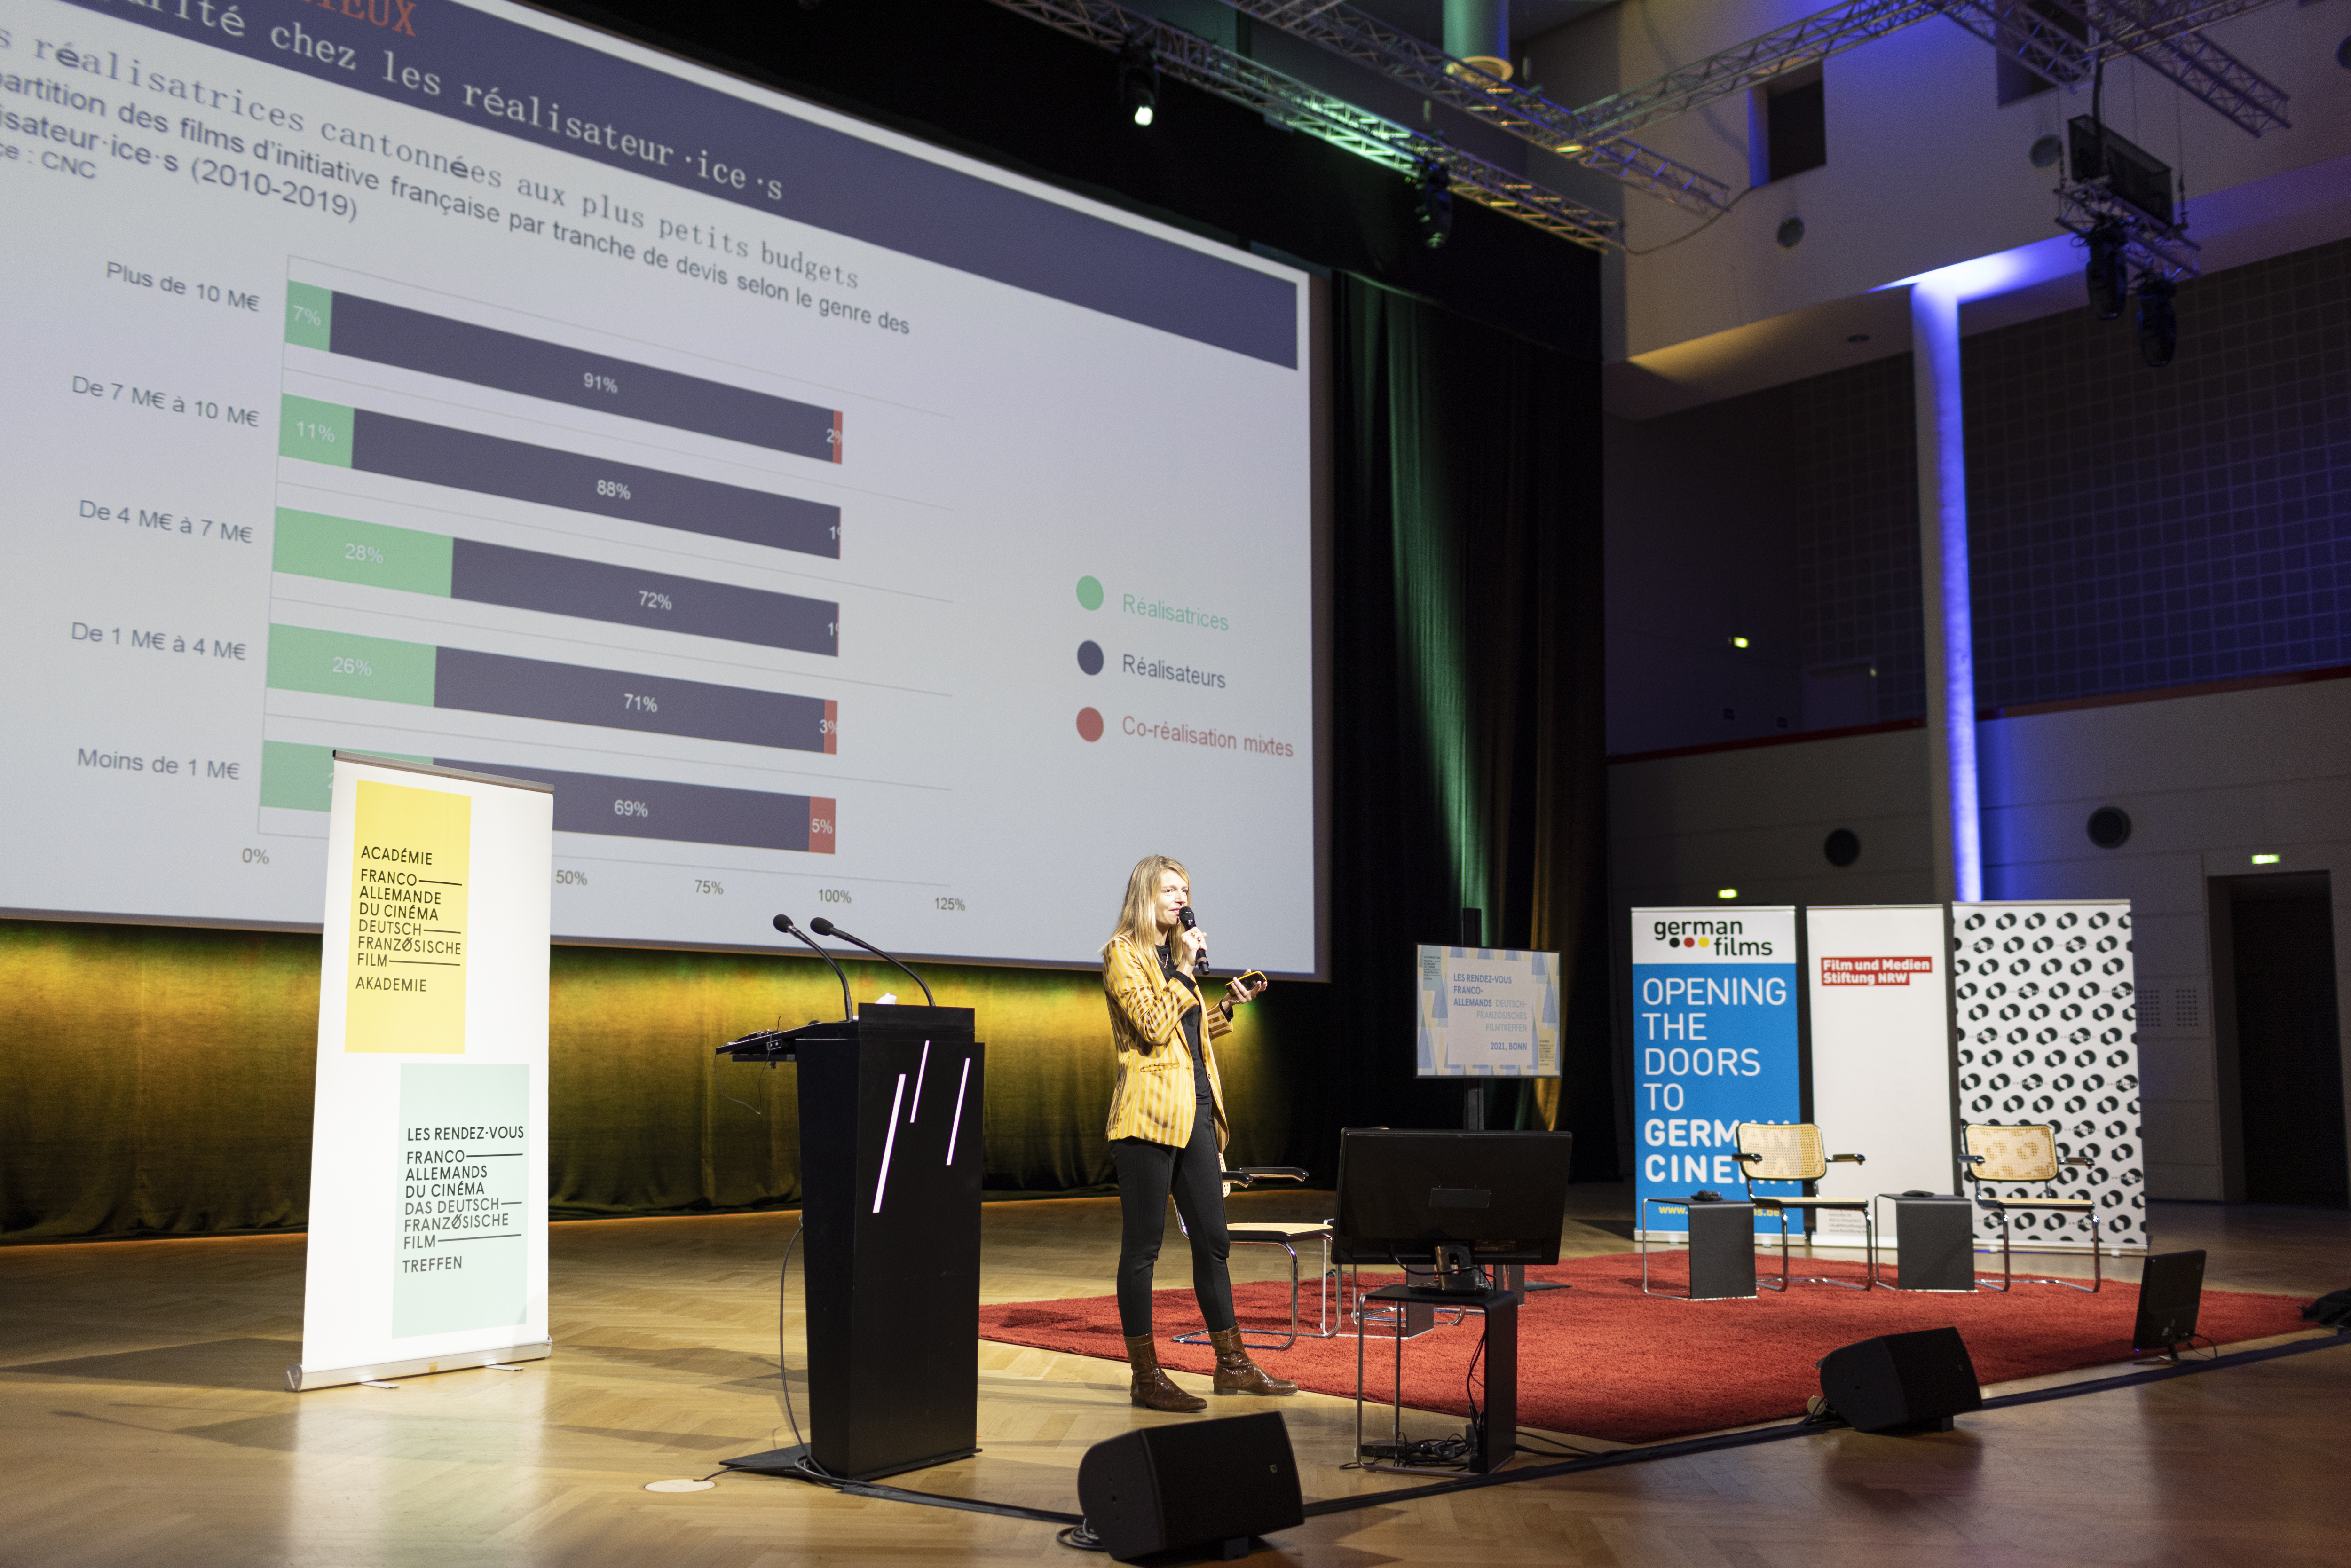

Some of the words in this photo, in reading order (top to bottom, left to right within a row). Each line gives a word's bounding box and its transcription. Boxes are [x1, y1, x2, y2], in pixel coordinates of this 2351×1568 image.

[271, 22, 356, 70] chez
[382, 50, 441, 95] les
[33, 39, 305, 132] réalisatrices
[321, 121, 502, 188] cantonnées
[518, 176, 567, 206] aux
[582, 193, 645, 229] plus
[659, 216, 749, 258] petits
[761, 241, 858, 289] budgets
[41, 150, 96, 179] CNC
[191, 157, 357, 223] (2010-2019)
[118, 102, 168, 133] des
[180, 117, 245, 154] films
[391, 176, 500, 222] française
[509, 211, 544, 236] par
[553, 220, 635, 260] tranche
[643, 246, 668, 268] de
[676, 256, 727, 285] devis
[737, 273, 789, 303] selon
[796, 286, 812, 309] le
[819, 297, 872, 325] genre
[878, 311, 910, 335] des
[106, 260, 153, 288] Plus
[160, 276, 186, 296] de
[196, 283, 220, 303] 10
[228, 289, 260, 312] M€
[292, 305, 322, 327] 7%
[584, 372, 618, 394] 91%
[72, 375, 104, 397] De
[111, 383, 124, 400] 7
[131, 386, 165, 410] M€
[172, 396, 185, 413] à
[194, 400, 219, 420] 10
[227, 406, 260, 427] M€
[295, 420, 335, 443] 11%
[596, 479, 631, 500] 88%
[79, 499, 110, 521] De
[117, 507, 130, 524] 4
[138, 509, 173, 531] M€
[179, 517, 193, 535] à
[200, 519, 213, 536] 7
[220, 522, 253, 544] M€
[344, 543, 384, 564] 28%
[639, 590, 672, 611] 72%
[1123, 593, 1229, 630] Réalisatrices
[71, 622, 103, 643] De
[111, 628, 120, 645] 1
[131, 629, 166, 651] M€
[172, 636, 185, 653] à
[192, 638, 206, 655] 4
[213, 639, 247, 661] M€
[332, 656, 372, 677] 26%
[1123, 654, 1226, 688] Réalisateurs
[623, 693, 658, 713] 71%
[1123, 716, 1237, 750] Co-réalisation
[1244, 734, 1294, 758] mixtes
[77, 748, 144, 771] Moins
[151, 756, 179, 774] de
[188, 759, 197, 776] 1
[207, 760, 240, 780] M€
[614, 799, 648, 817] 69%
[811, 819, 833, 835] 5%
[361, 845, 433, 865] ACADÉMIE
[241, 848, 269, 865] 0%
[556, 869, 587, 886] 50%
[694, 879, 724, 895] 75%
[818, 889, 852, 905] 100%
[934, 897, 965, 913] 125%
[361, 868, 417, 886] FRANCO
[359, 885, 442, 905] ALLEMANDE
[360, 902, 379, 916] DU
[384, 904, 438, 921] CINÉMA
[359, 919, 422, 936] DEUTSCH
[1654, 920, 1743, 941] german
[1714, 936, 1773, 956] films
[357, 953, 387, 967] FILM
[1823, 959, 1852, 971] Film
[1855, 959, 1879, 971] und
[1882, 959, 1930, 970] Medien
[355, 976, 426, 992] AKADEMIE
[1467, 974, 1512, 984] RENDEZ-VOUS
[1823, 972, 1875, 985] Stiftung
[1878, 972, 1907, 984] NRW
[1453, 986, 1483, 994] FRANCO-
[1643, 977, 1786, 1006] OPENING
[1453, 998, 1492, 1007] ALLEMANDS
[1495, 1000, 1527, 1008] DEUTSCH-
[1476, 1010, 1527, 1020] FRANZÖSISCHES
[1486, 1023, 1527, 1032] FILMTREFFEN
[1642, 1012, 1707, 1040] THE
[1491, 1042, 1507, 1051] 2021,
[1645, 1048, 1761, 1077] DOORS
[1643, 1083, 1684, 1111] TO
[408, 1127, 430, 1141] LES
[435, 1126, 524, 1141] RENDEZ-VOUS
[407, 1150, 465, 1165] FRANCO
[405, 1165, 488, 1182] ALLEMANDS
[406, 1184, 426, 1198] DU
[431, 1181, 485, 1197] CINÉMA
[405, 1201, 432, 1215] DAS
[438, 1197, 499, 1213] DEUTSCH
[404, 1234, 435, 1250] FILM
[402, 1256, 462, 1273] TREFFEN
